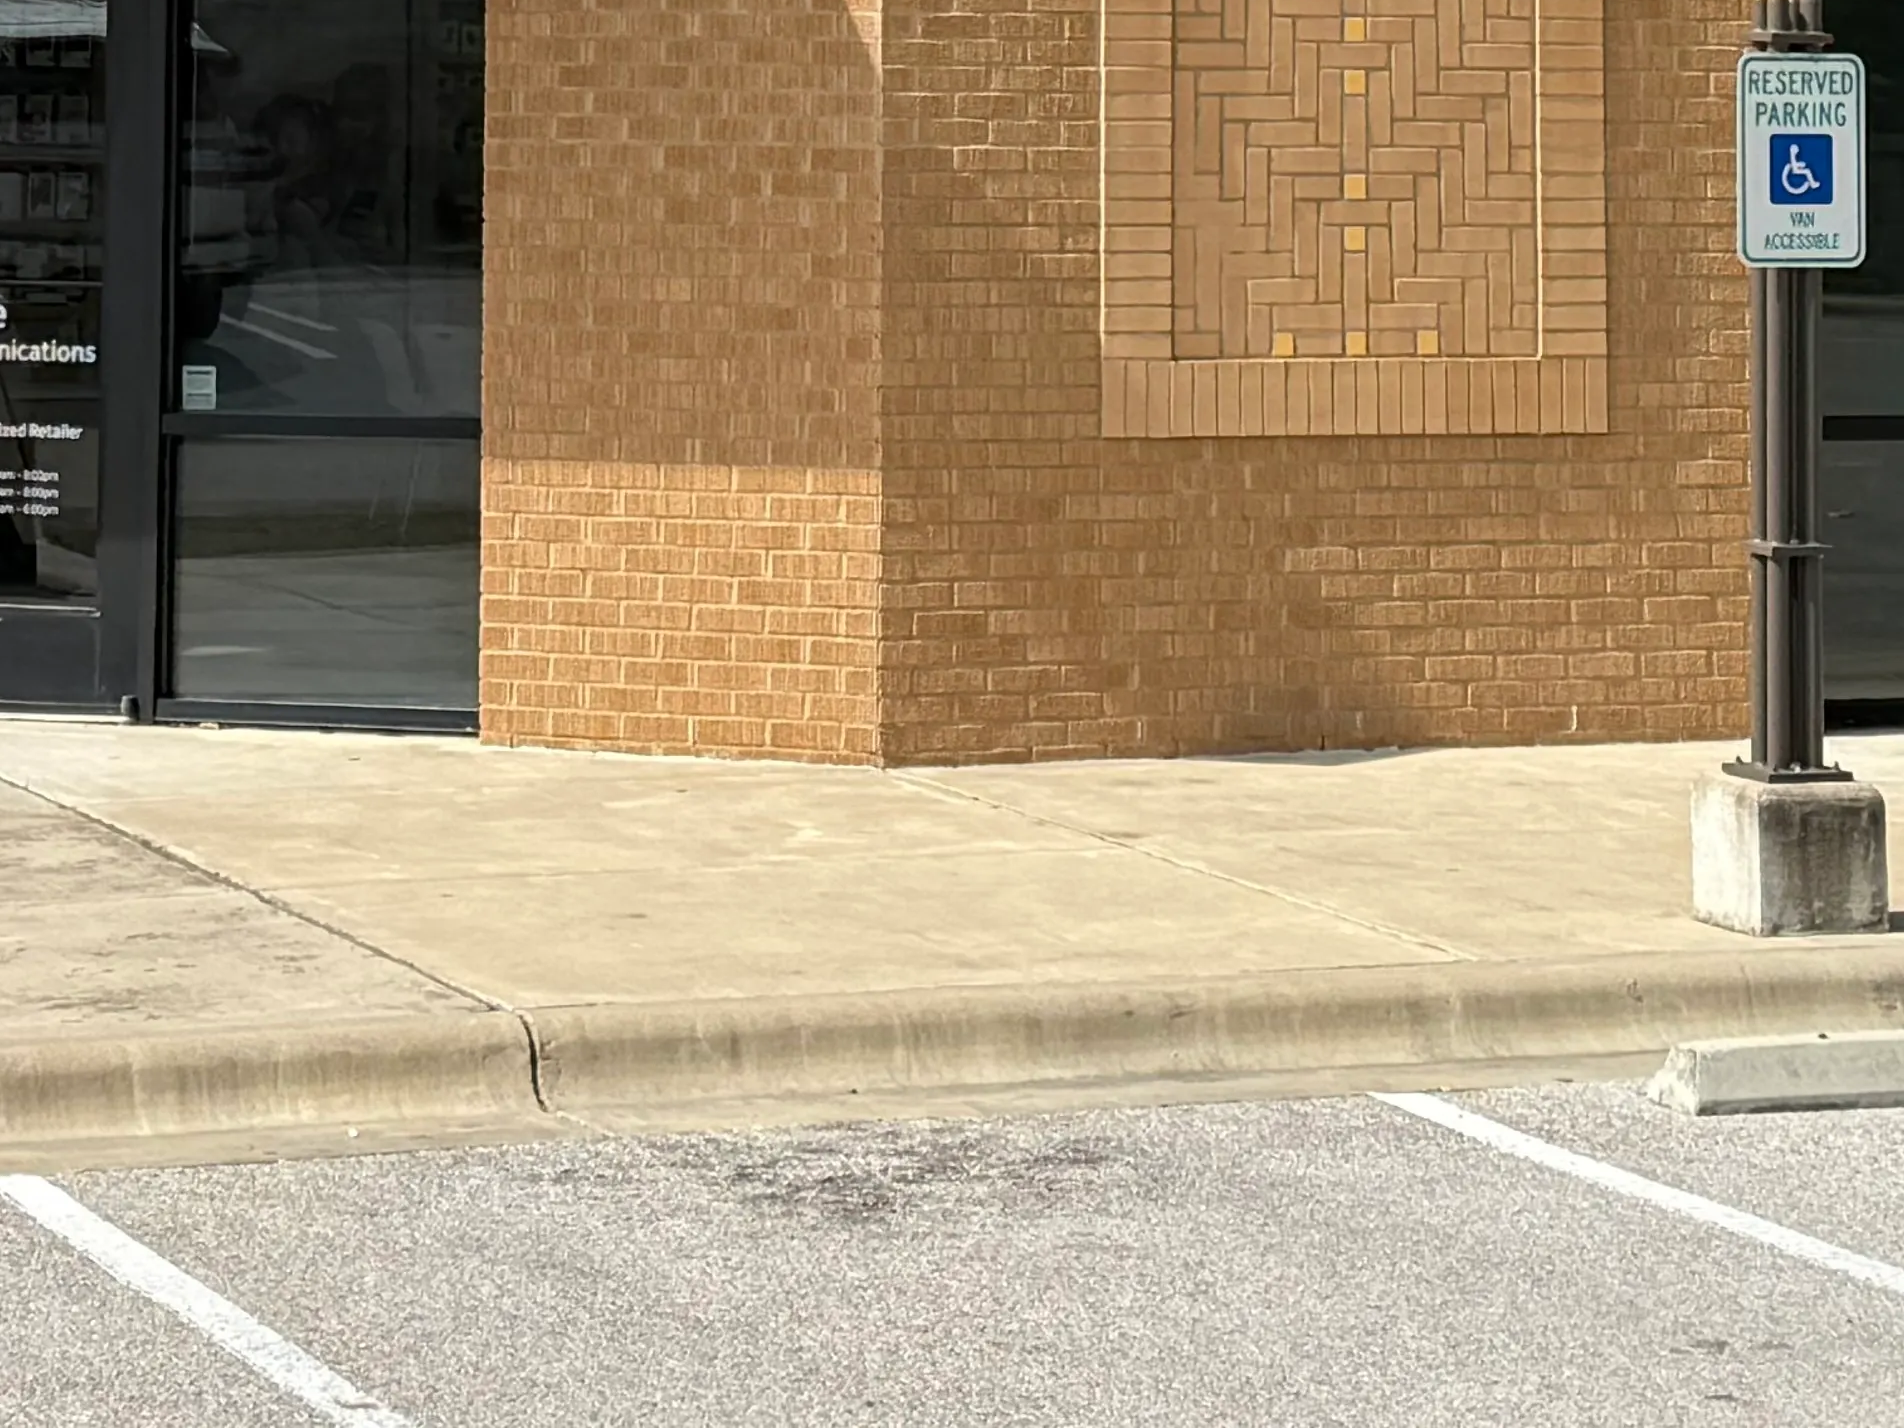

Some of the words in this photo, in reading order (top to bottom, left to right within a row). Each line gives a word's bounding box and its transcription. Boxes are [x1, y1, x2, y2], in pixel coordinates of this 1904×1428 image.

[1749, 70, 1853, 95] RESERVED
[1755, 102, 1847, 127] PARKING
[1790, 212, 1815, 228] VAN
[1764, 233, 1840, 250] ACCESSIBLE
[28, 423, 83, 440] Retailer
